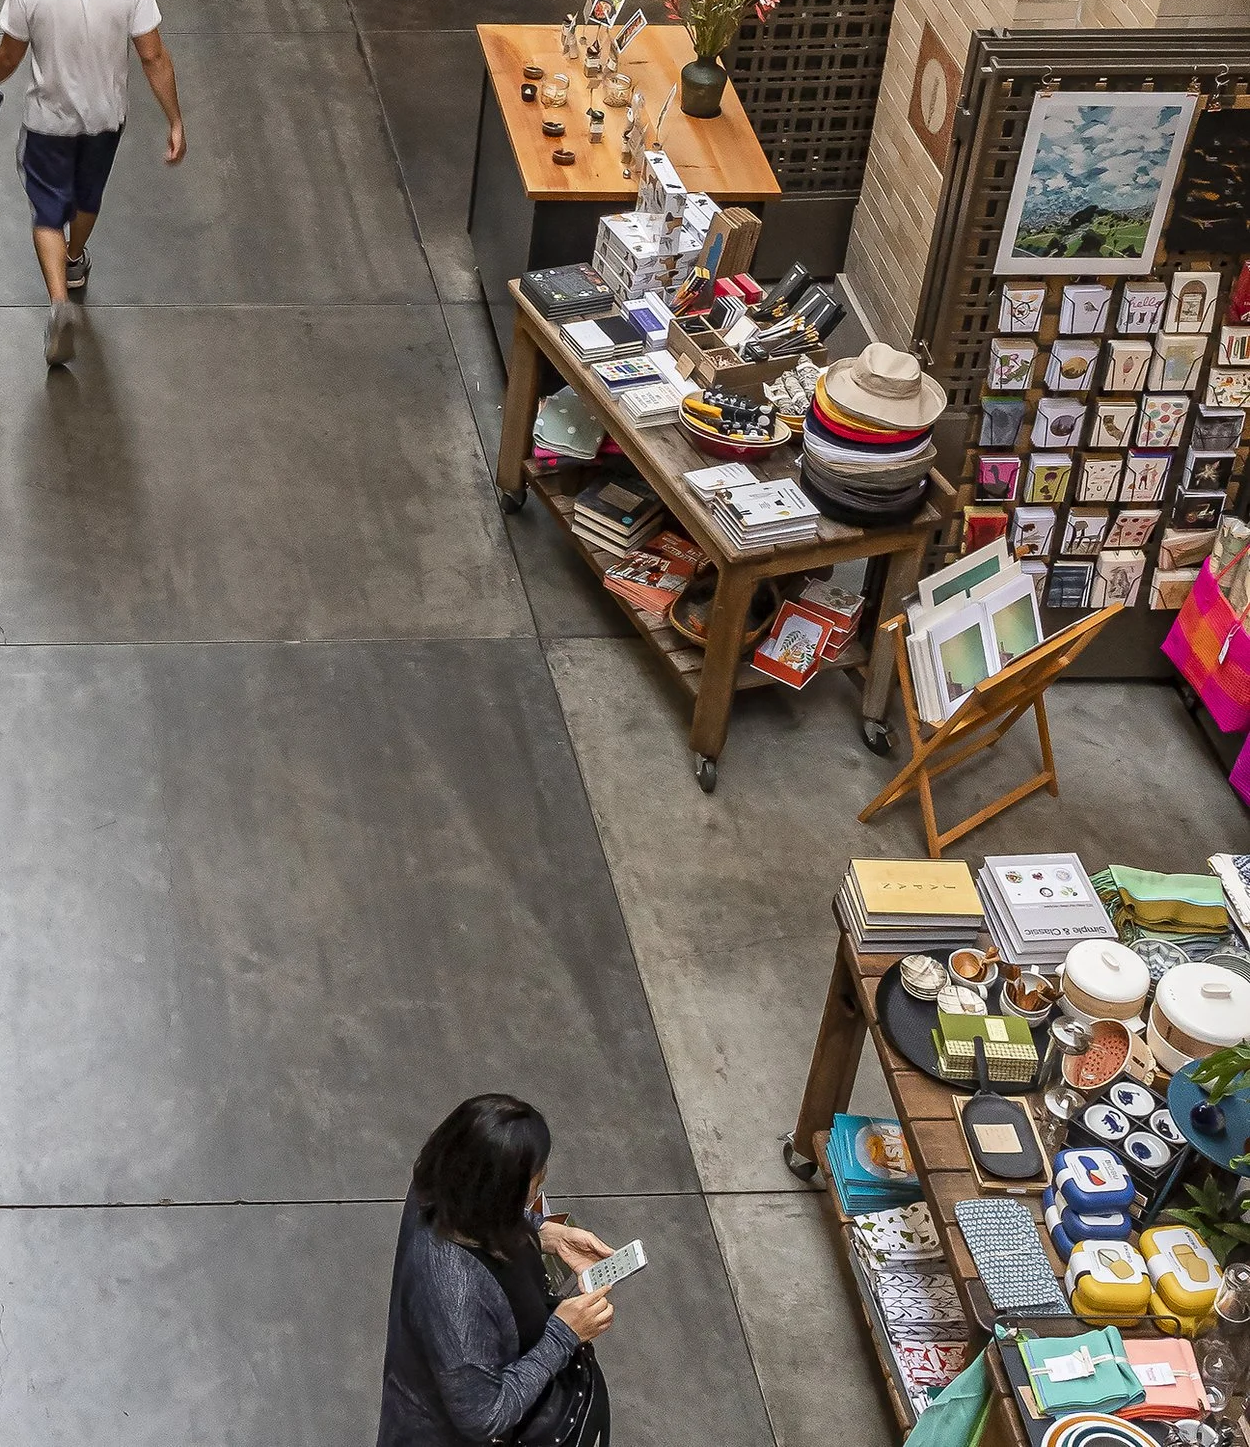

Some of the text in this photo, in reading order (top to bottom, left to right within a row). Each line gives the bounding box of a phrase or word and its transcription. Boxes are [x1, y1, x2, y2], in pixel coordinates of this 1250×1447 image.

[1129, 296, 1164, 308] hello
[1024, 927, 1062, 936] Classic
[1072, 926, 1107, 935] Simple
